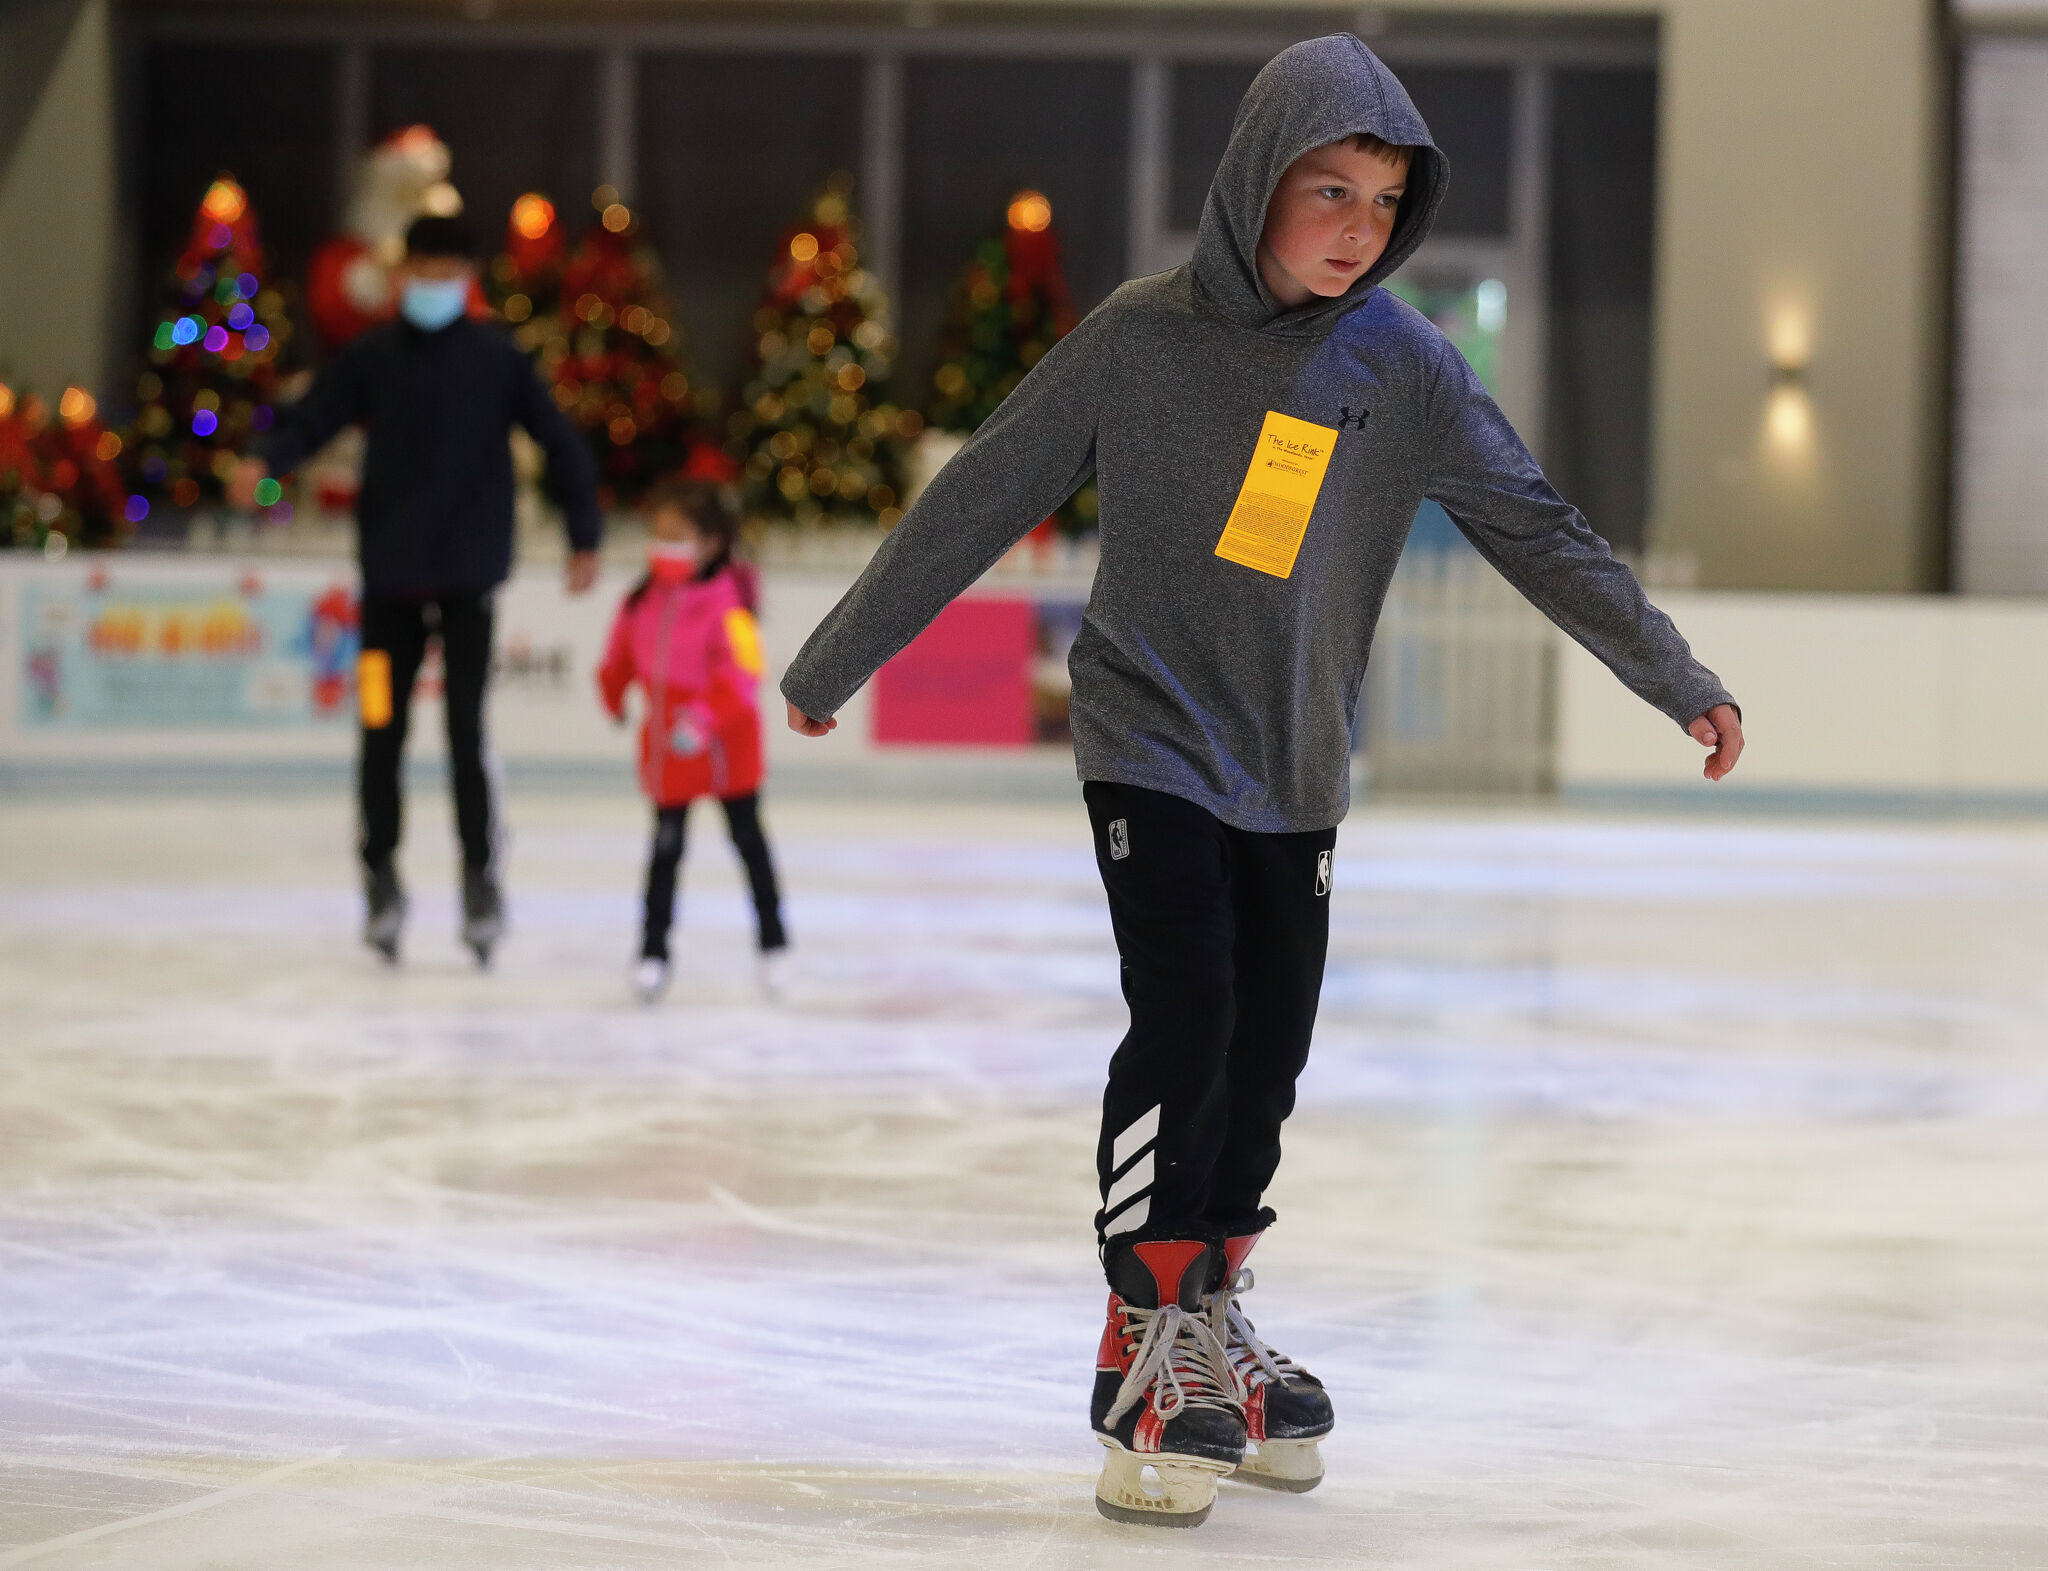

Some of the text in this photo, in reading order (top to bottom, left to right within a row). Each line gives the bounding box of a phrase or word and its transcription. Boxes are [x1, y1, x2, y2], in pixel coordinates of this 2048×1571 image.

[1267, 434, 1284, 446] The
[1286, 440, 1299, 451] Ice
[1301, 443, 1320, 457] Rink
